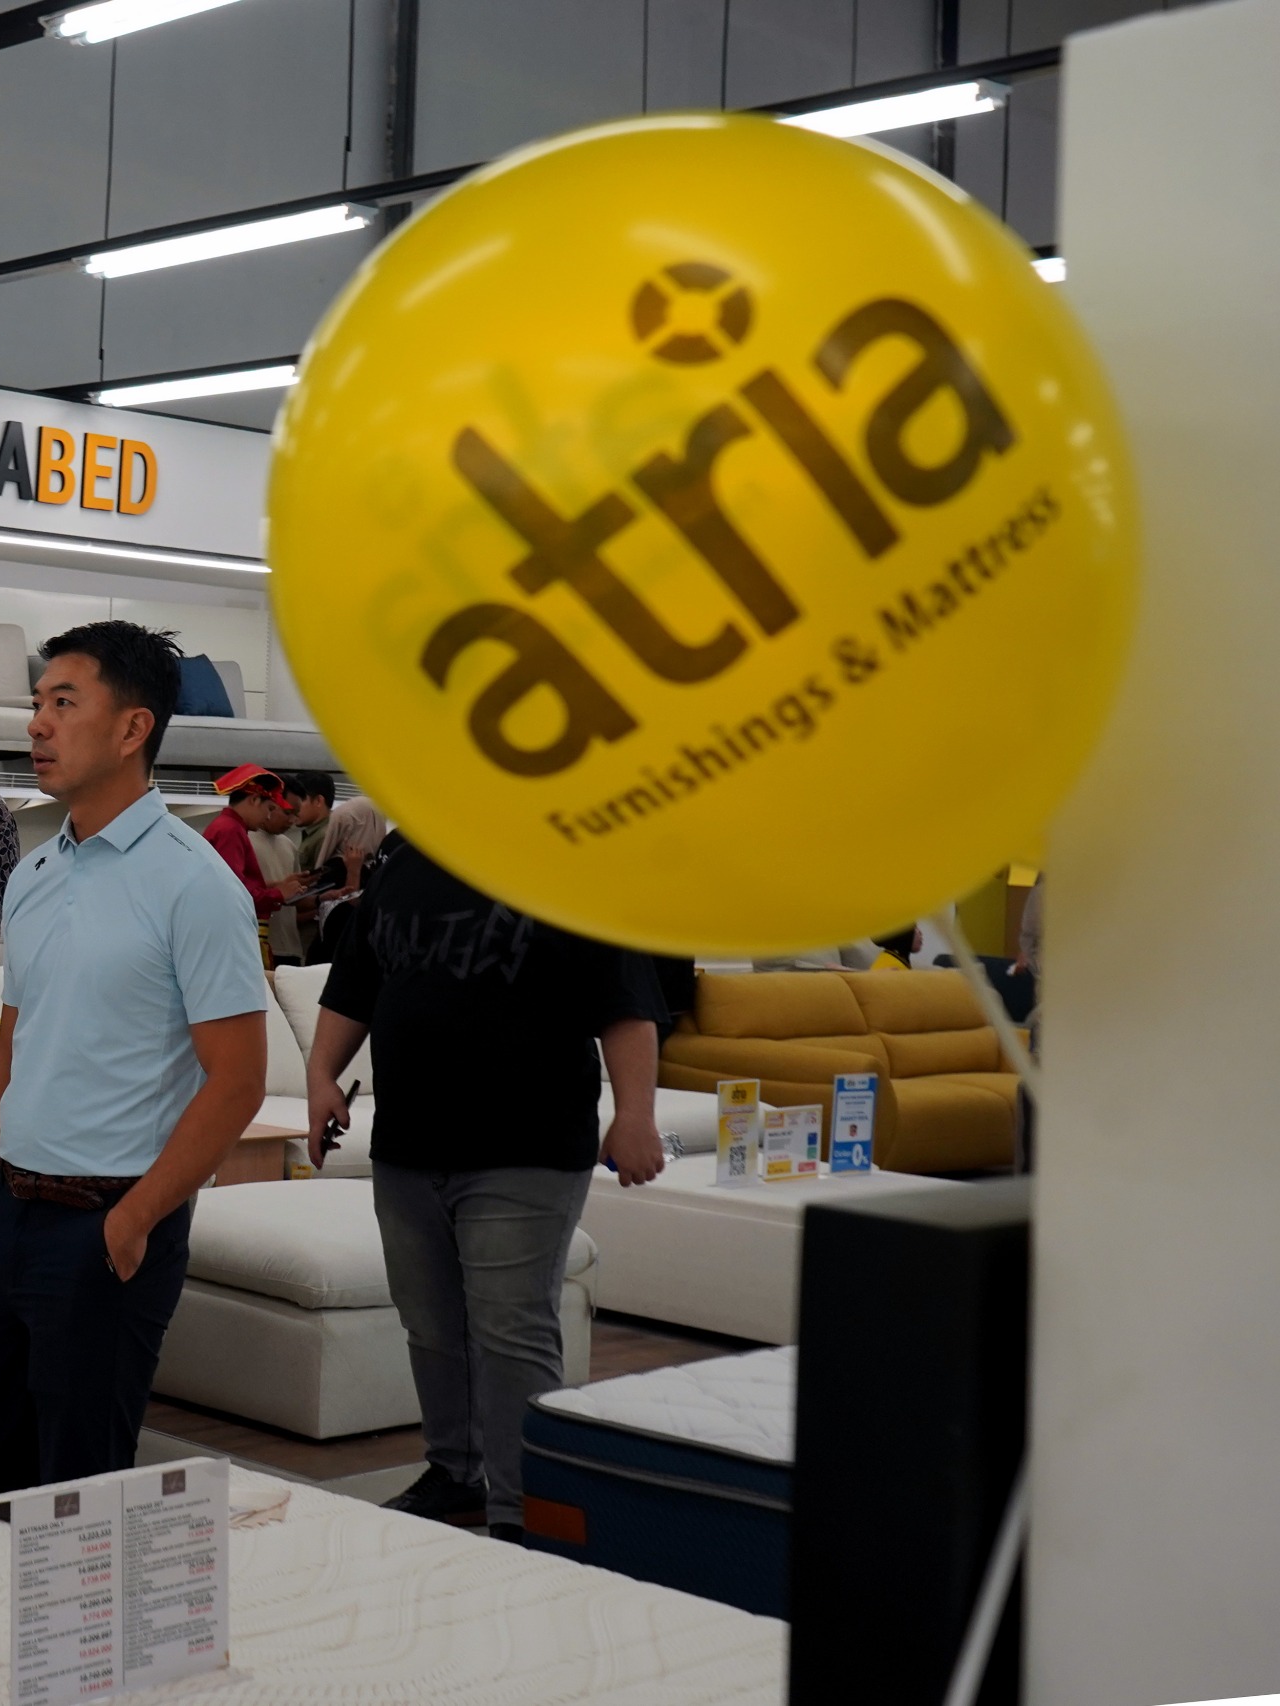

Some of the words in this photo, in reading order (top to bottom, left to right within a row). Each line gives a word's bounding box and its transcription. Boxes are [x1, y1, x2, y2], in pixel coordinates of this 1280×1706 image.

[418, 260, 1019, 779] atria
[545, 668, 833, 845] Furnishings
[830, 636, 884, 687] &
[878, 486, 1063, 653] Mattress
